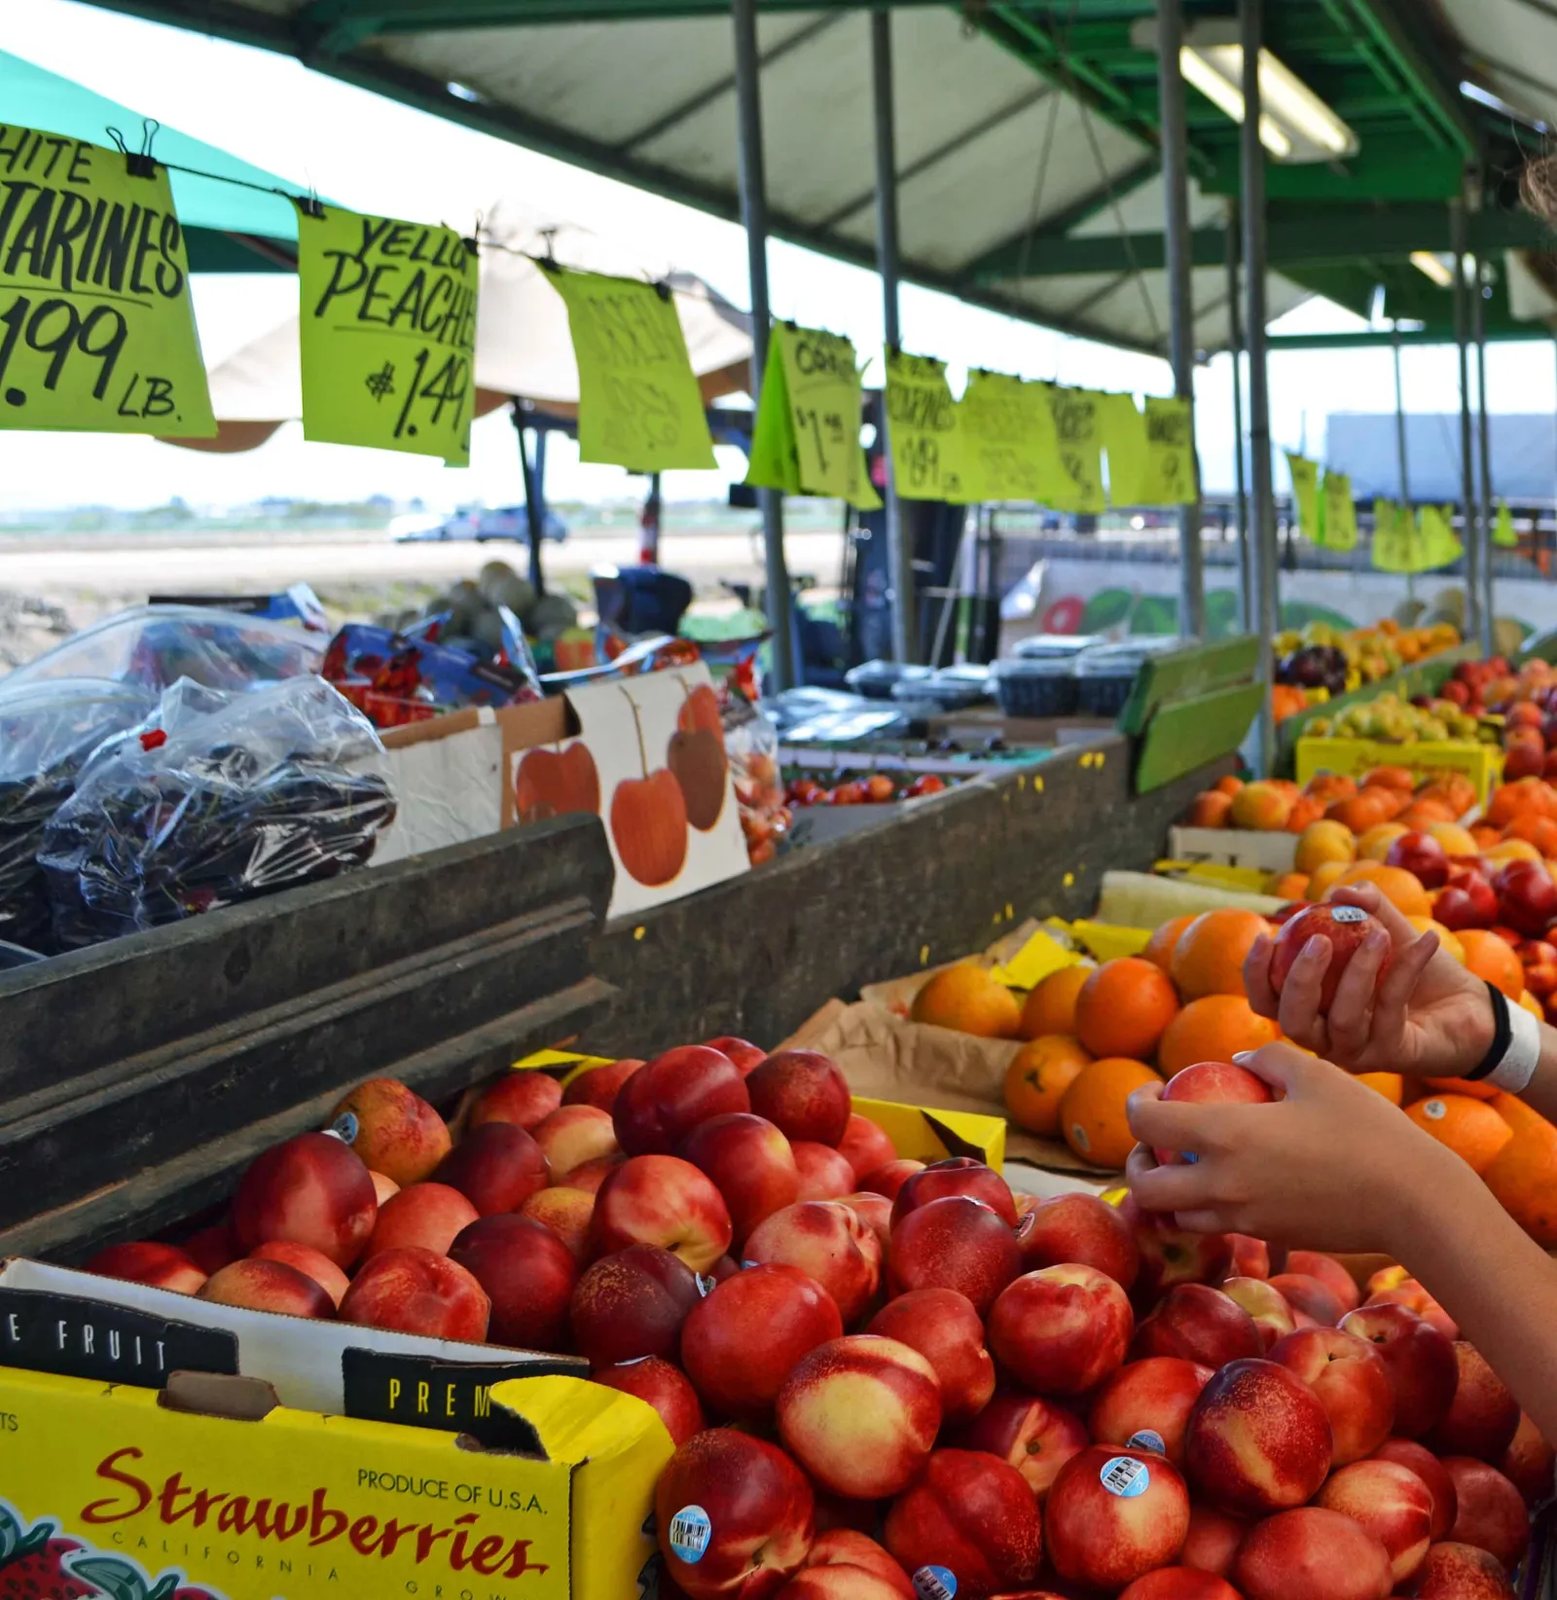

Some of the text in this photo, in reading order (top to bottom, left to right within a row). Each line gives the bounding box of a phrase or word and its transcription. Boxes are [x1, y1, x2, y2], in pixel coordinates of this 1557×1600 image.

[118, 373, 182, 422] LB.
[58, 1320, 165, 1370] FRUIT
[80, 1446, 550, 1579] Strawberries
[358, 1468, 548, 1515] PRODUCE OF U.S.A.
[112, 1531, 508, 1600] CALIFORNIA GROW
